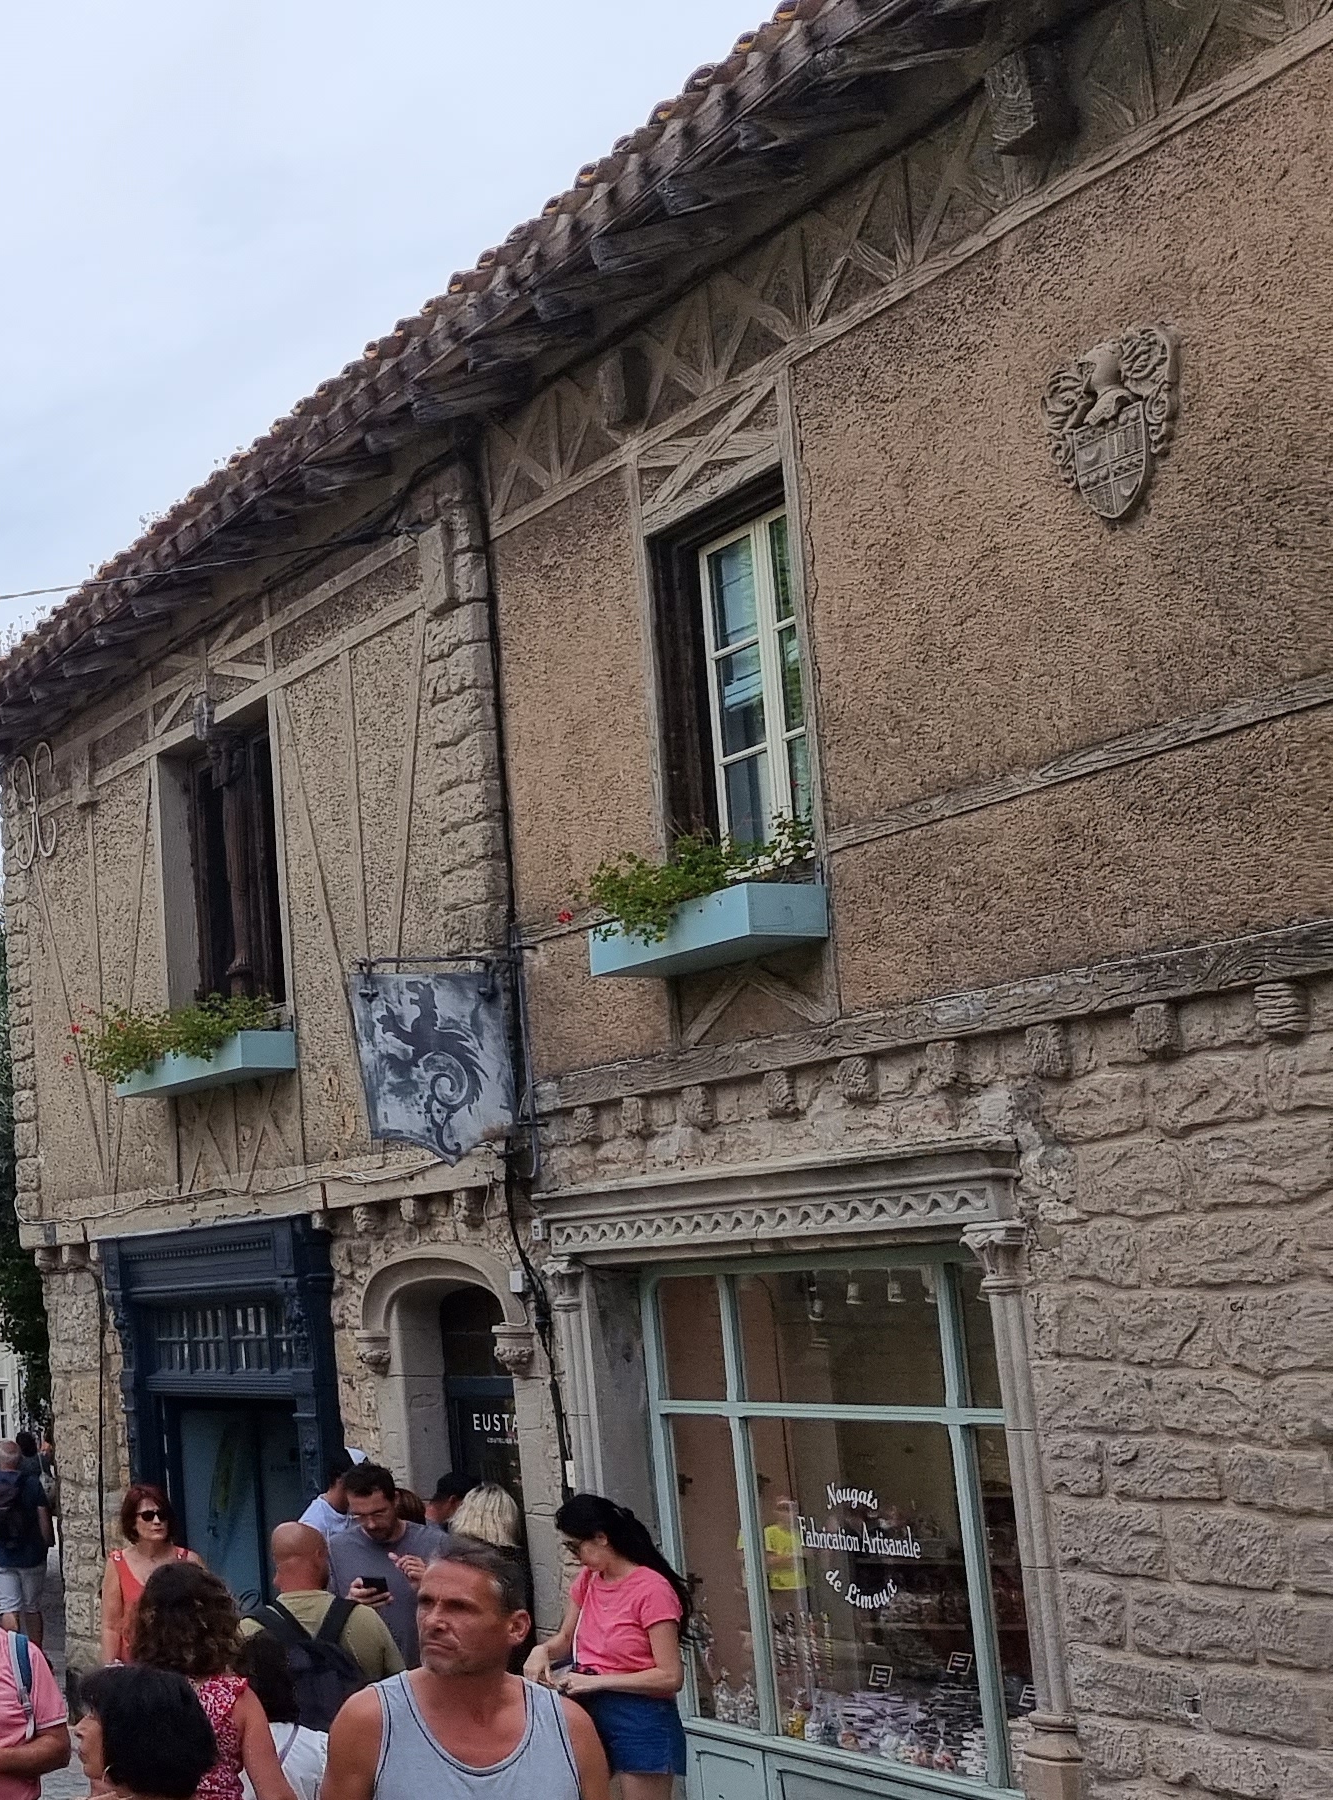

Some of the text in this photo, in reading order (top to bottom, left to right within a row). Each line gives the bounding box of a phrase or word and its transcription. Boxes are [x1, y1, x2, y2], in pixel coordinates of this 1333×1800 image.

[473, 1413, 518, 1432] EUSTA
[826, 1482, 878, 1510] Nougats
[797, 1515, 921, 1559] Fabrication Artisanale
[825, 1569, 897, 1610] de Limoux
